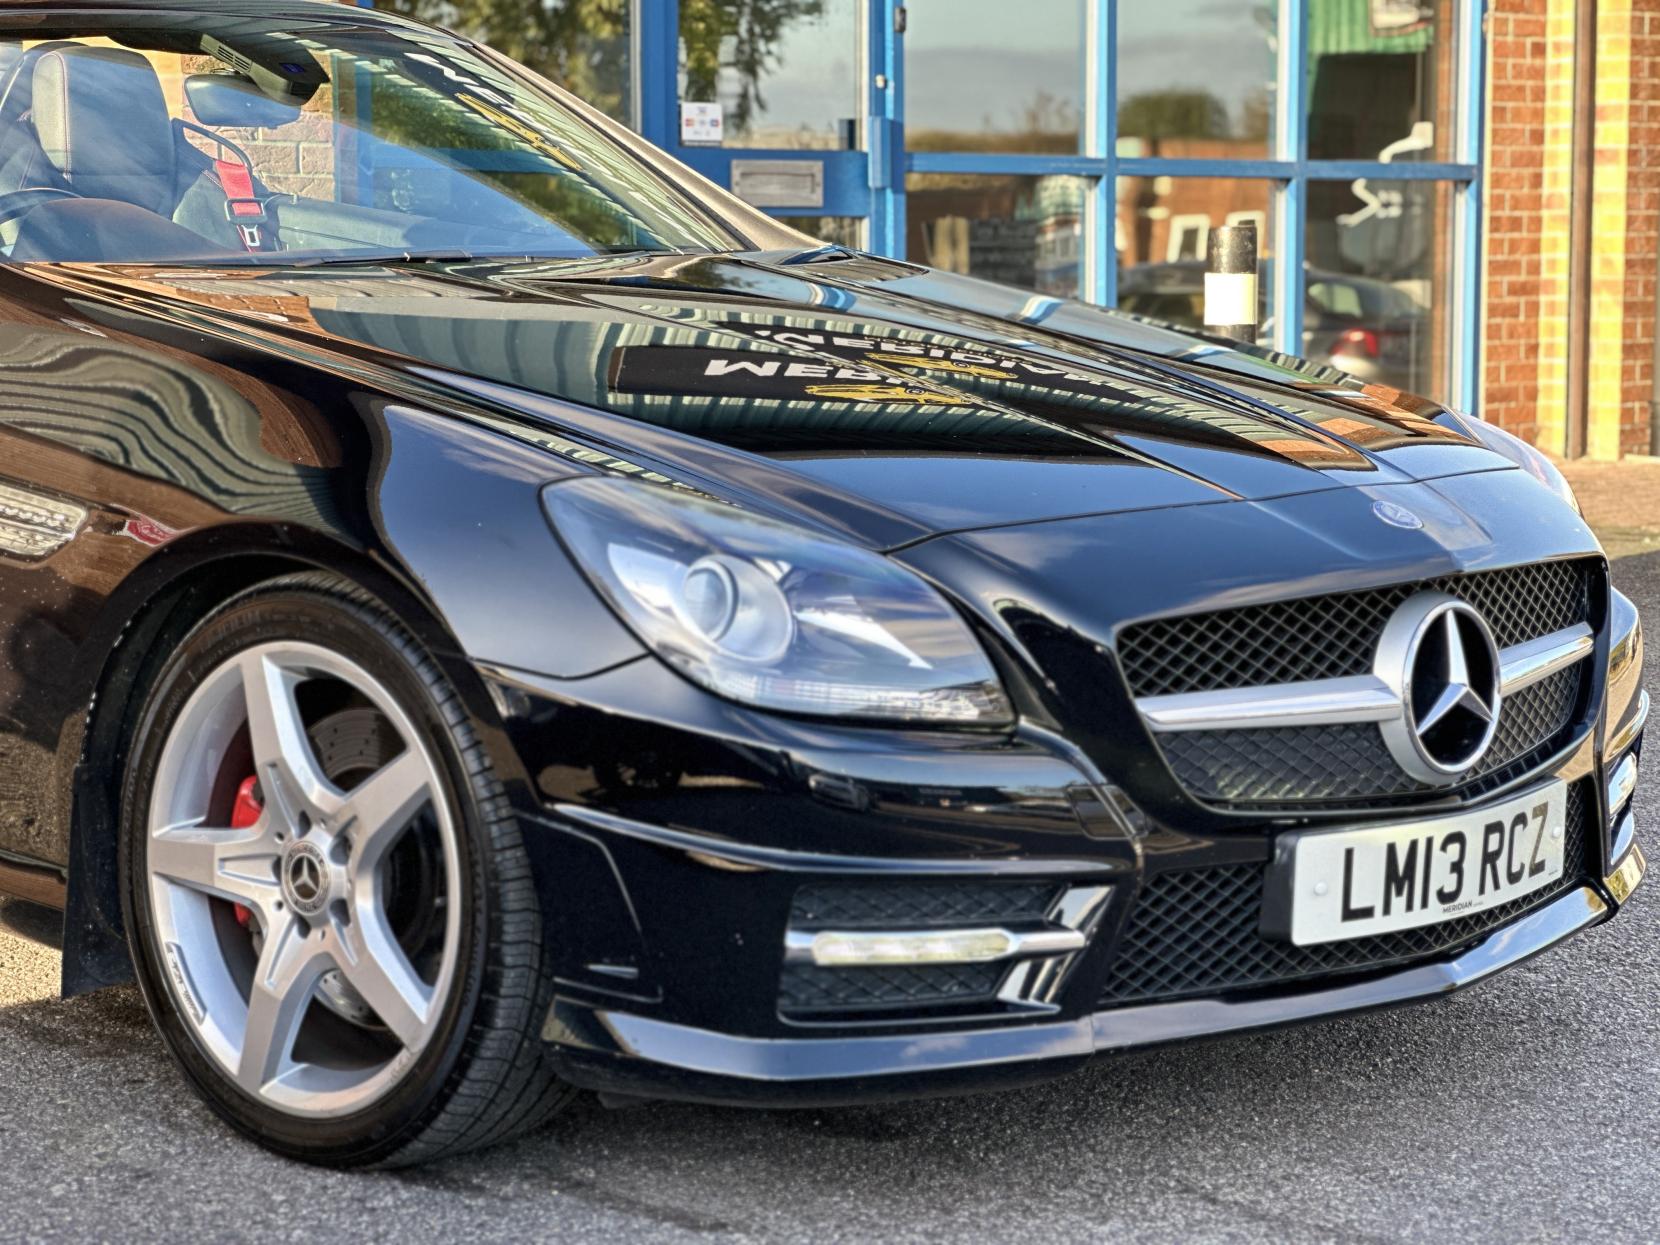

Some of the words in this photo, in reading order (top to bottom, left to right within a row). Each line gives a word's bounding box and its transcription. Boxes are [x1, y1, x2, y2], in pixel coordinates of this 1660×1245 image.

[1341, 830, 1467, 922] LM13
[1478, 801, 1548, 896] RCZ
[1442, 900, 1473, 914] MERIDIAN
